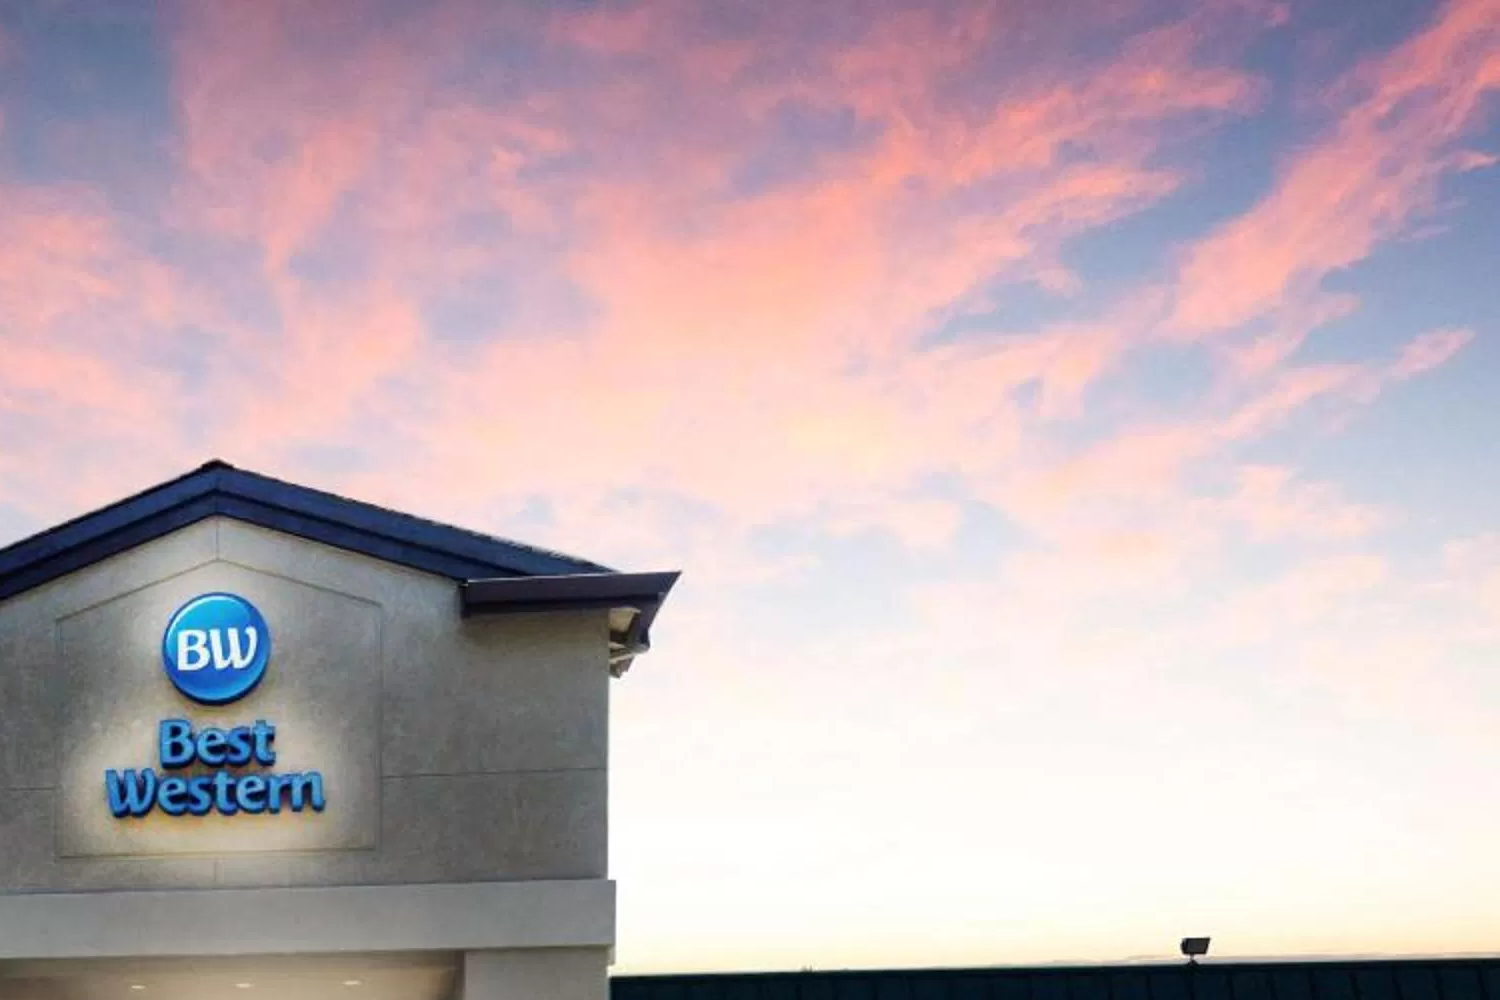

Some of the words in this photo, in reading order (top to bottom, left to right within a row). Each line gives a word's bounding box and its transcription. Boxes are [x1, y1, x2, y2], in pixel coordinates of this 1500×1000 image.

[177, 626, 258, 671] BW
[160, 719, 276, 767] Best
[105, 768, 326, 817] Western
